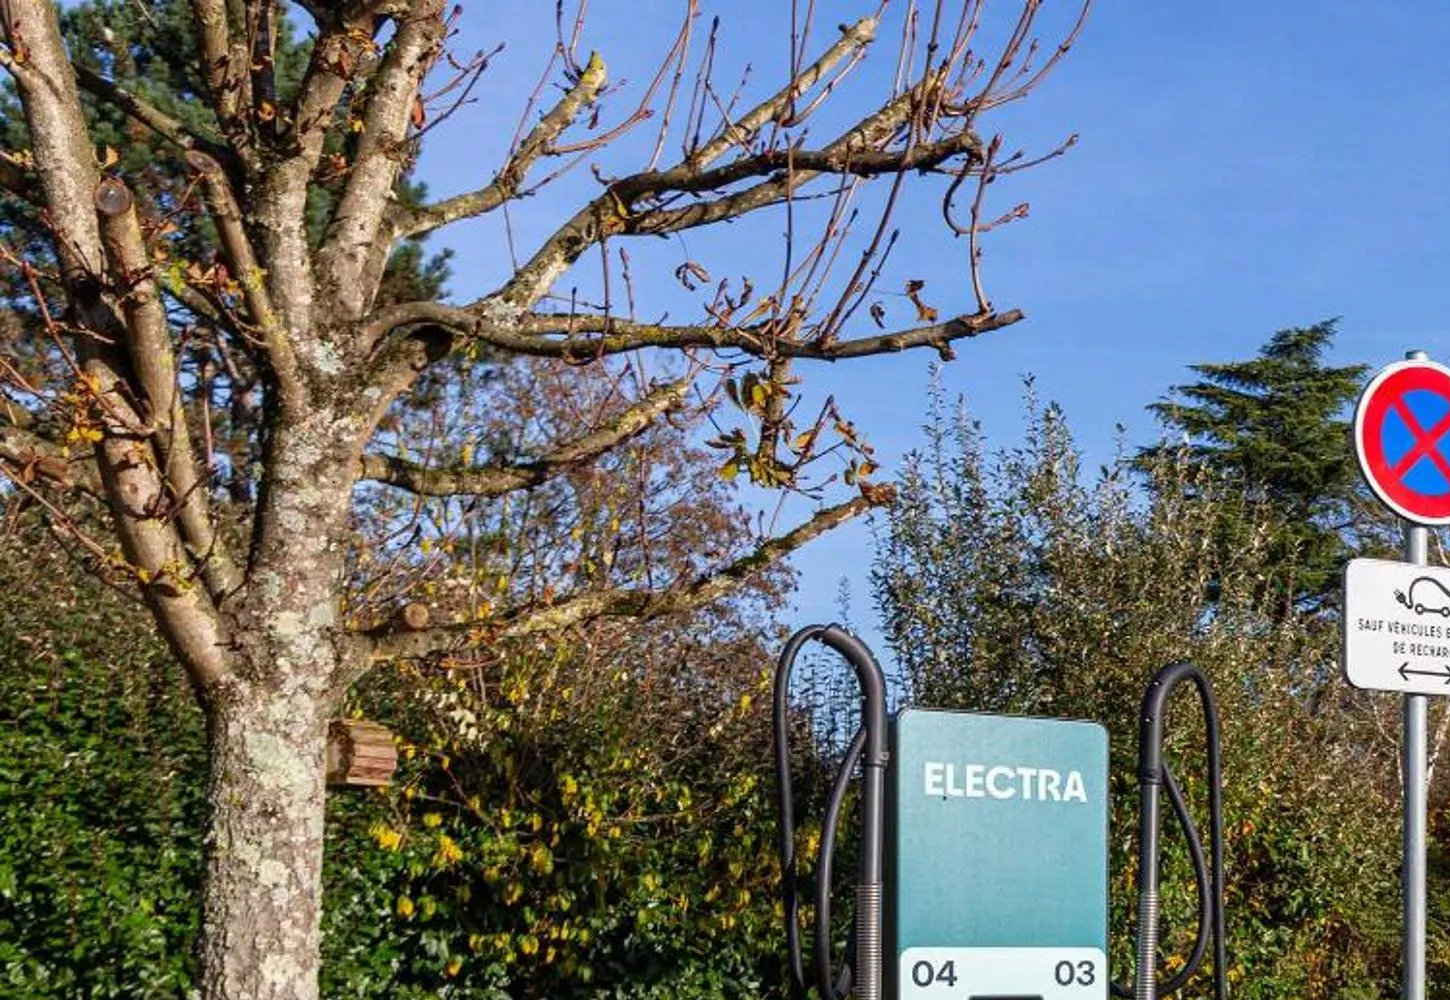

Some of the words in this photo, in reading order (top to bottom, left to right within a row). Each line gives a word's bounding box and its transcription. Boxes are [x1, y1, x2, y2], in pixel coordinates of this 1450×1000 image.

[1358, 617, 1384, 632] SAUF
[1392, 641, 1406, 655] DE
[924, 762, 1088, 803] ELECTRA
[912, 960, 958, 988] 04
[1054, 960, 1096, 987] 03
